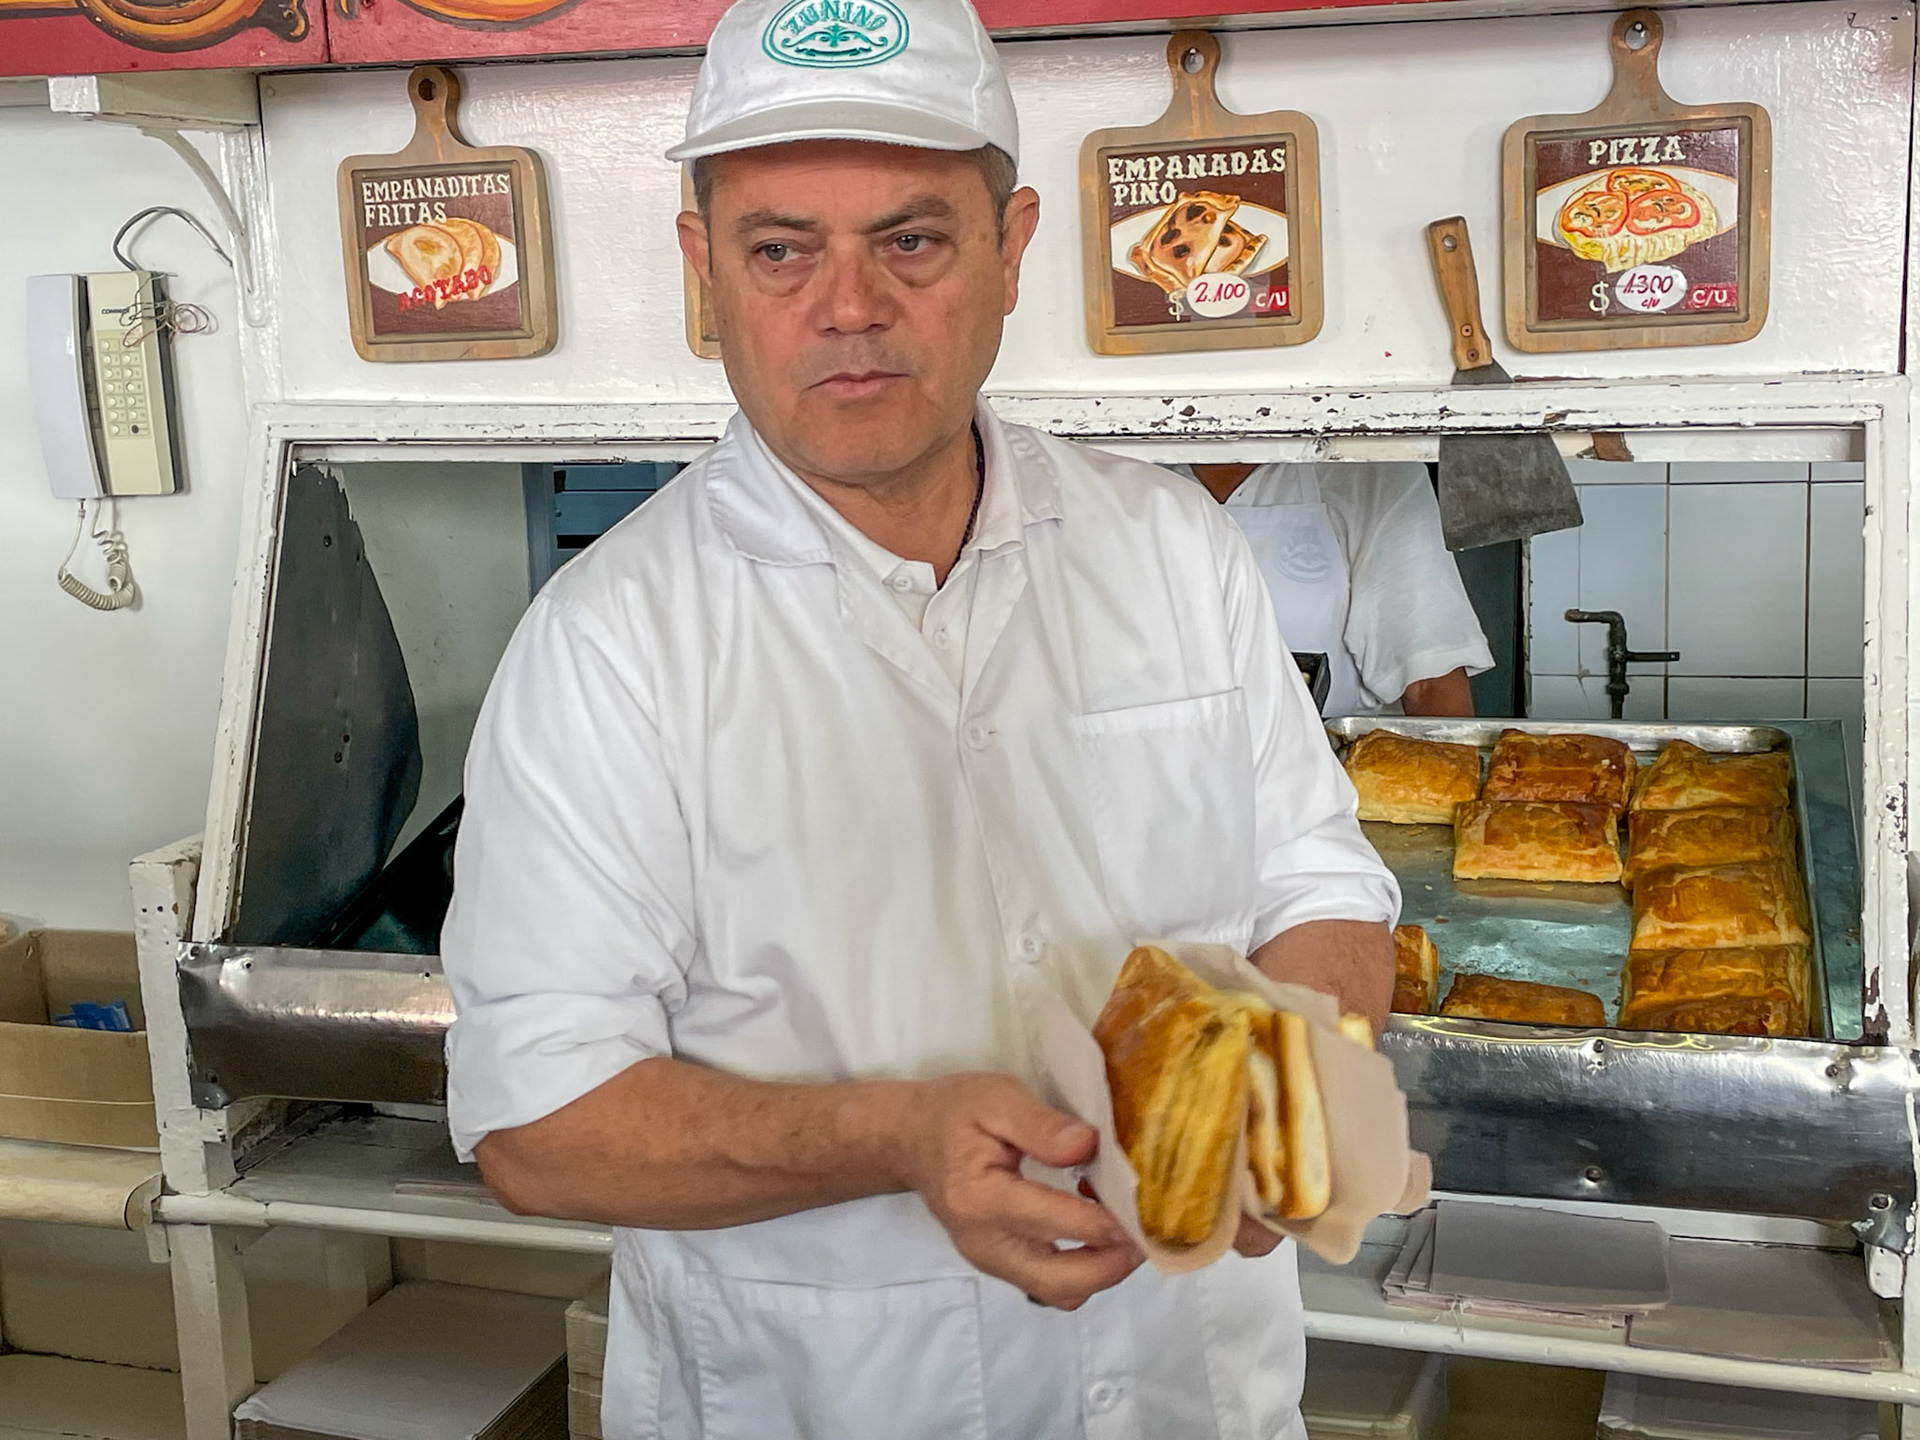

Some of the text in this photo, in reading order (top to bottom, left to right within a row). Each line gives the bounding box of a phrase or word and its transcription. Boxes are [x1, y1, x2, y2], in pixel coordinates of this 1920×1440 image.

[782, 0, 887, 35] ZUNINO
[1588, 135, 1686, 165] PIZZA
[1108, 148, 1286, 184] EMPANADAS
[362, 173, 510, 203] EMPANADITAS
[1113, 181, 1177, 206] PINO
[365, 203, 447, 228] FRITAS
[1692, 289, 1728, 306] C/U
